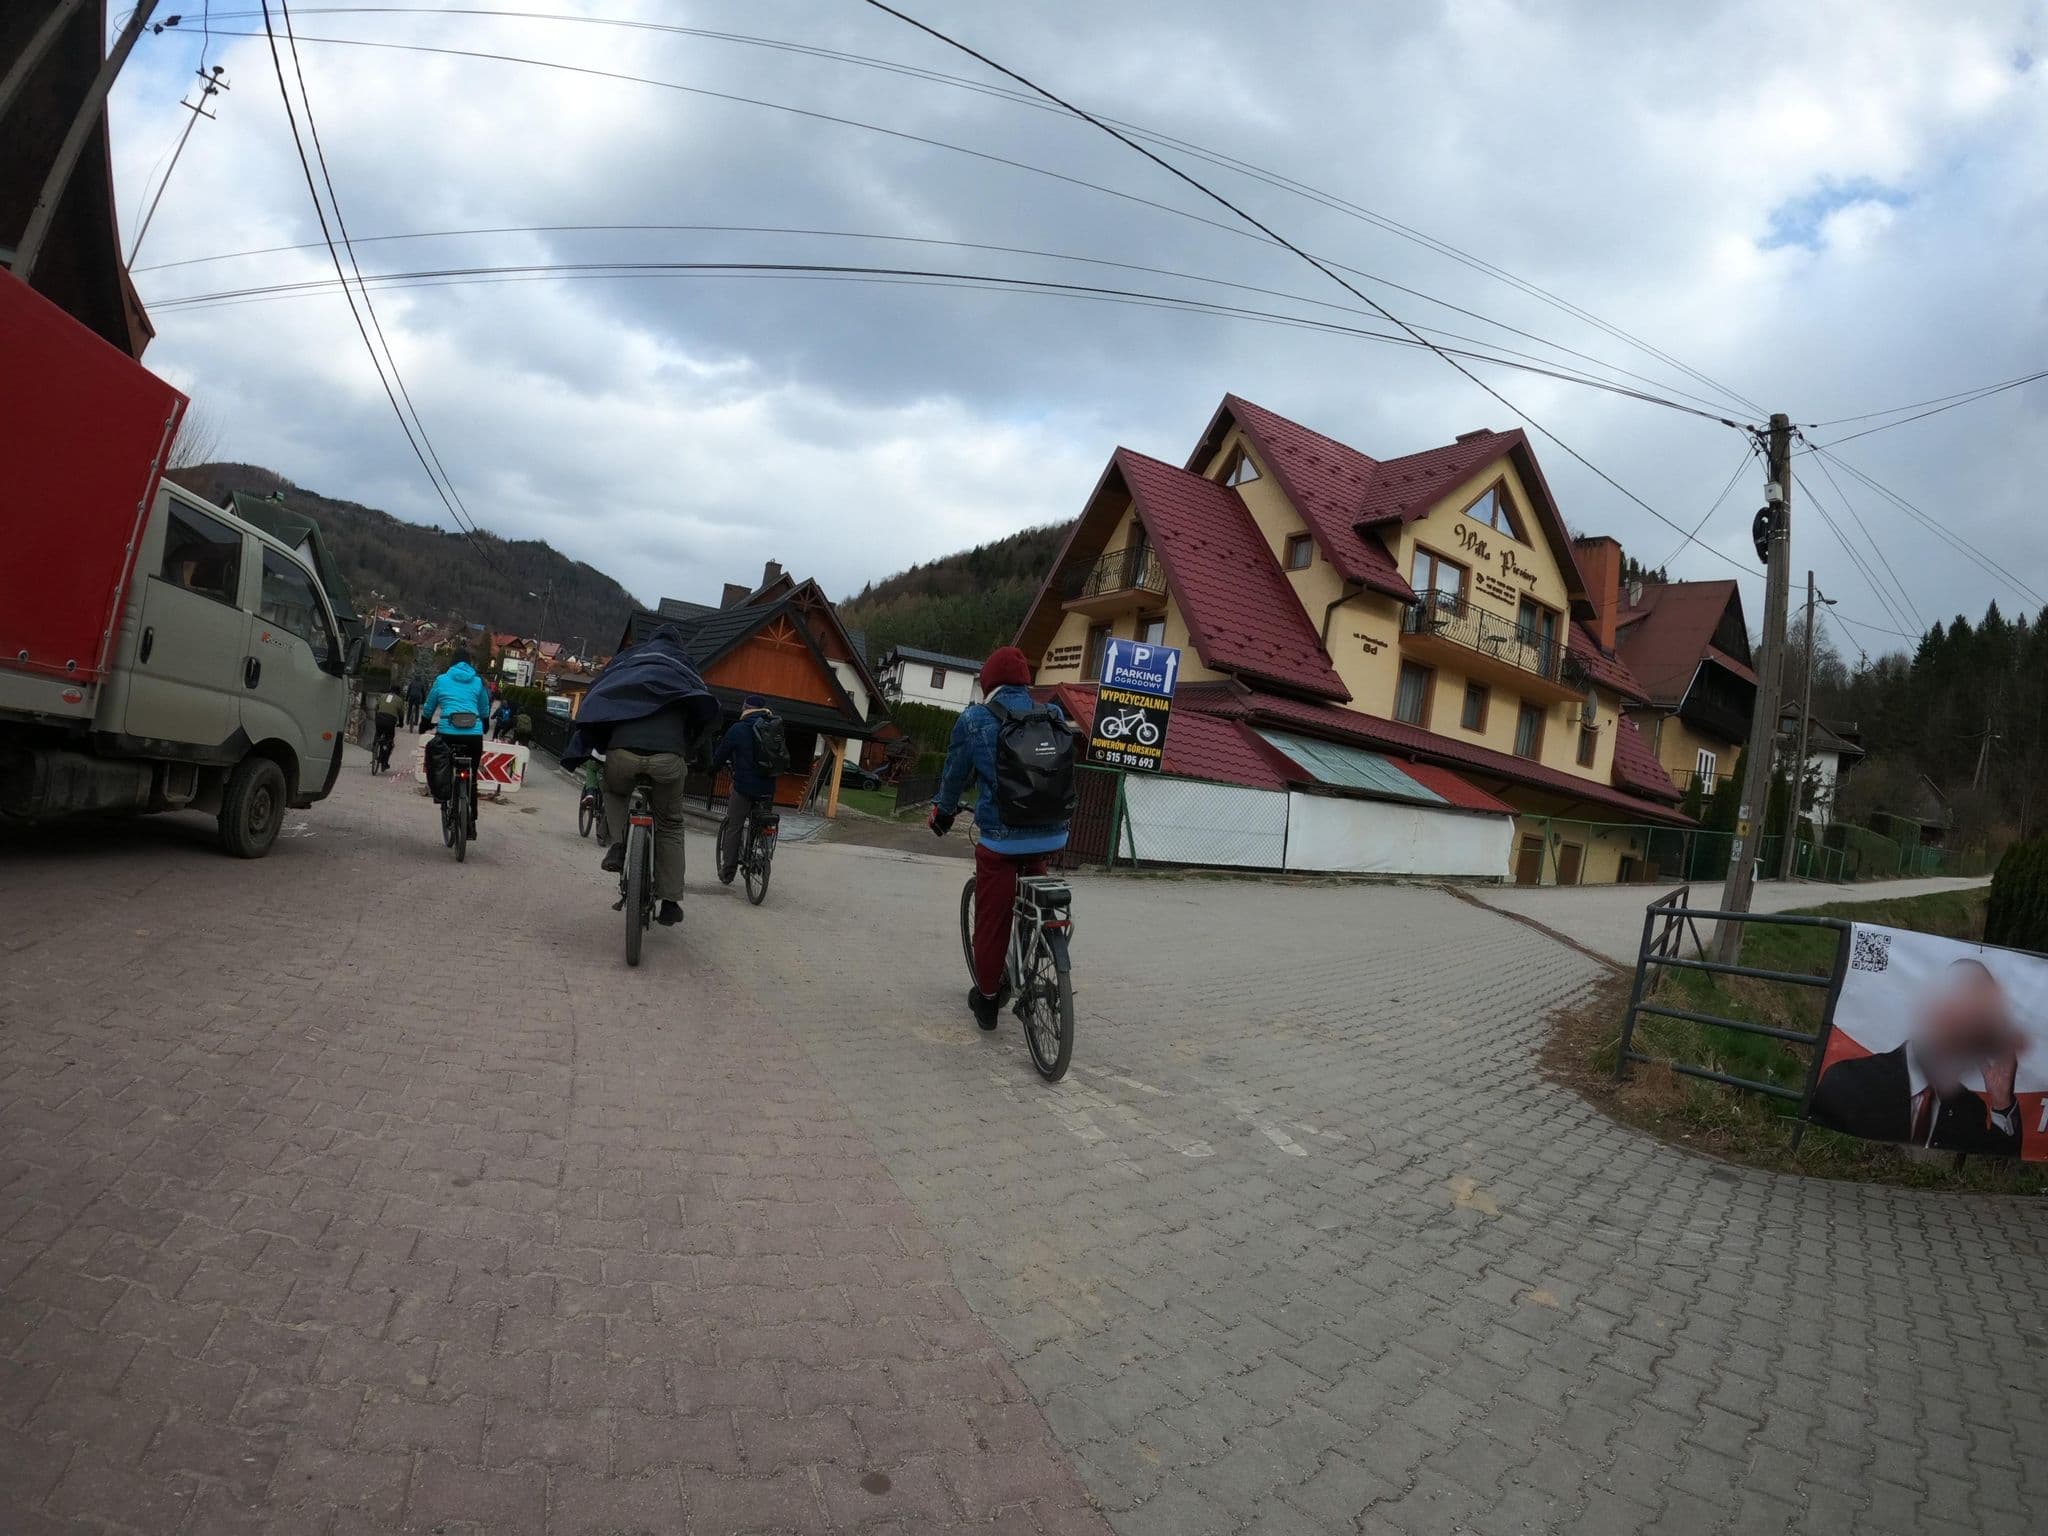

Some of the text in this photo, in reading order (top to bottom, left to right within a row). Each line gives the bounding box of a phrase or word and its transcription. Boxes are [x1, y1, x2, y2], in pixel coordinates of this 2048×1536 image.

[1134, 647, 1151, 666] P
[1115, 667, 1162, 683] PARKING
[1115, 676, 1161, 689] OGRODOWY
[1100, 689, 1169, 711] WYPOŻYCZALNIA
[1092, 737, 1162, 757] ROWERÓW GÓRSKICH
[1106, 751, 1154, 768] 515 195 693
